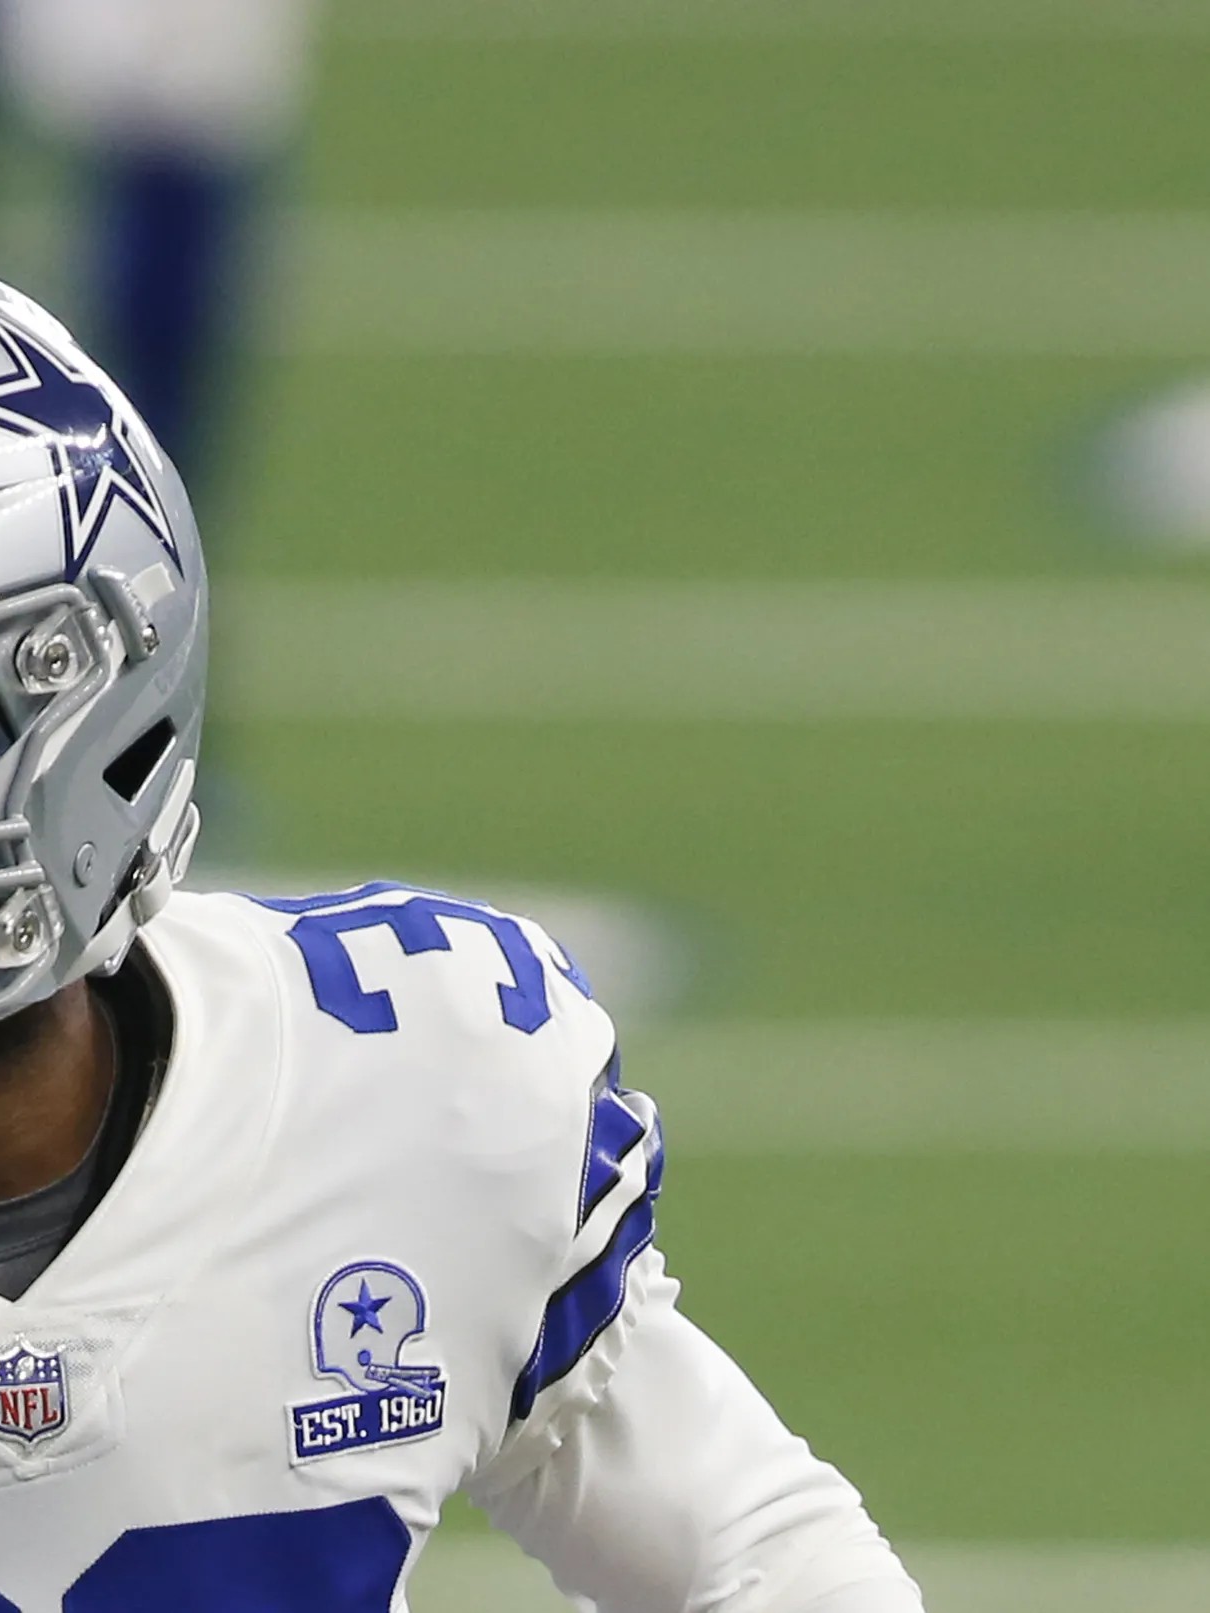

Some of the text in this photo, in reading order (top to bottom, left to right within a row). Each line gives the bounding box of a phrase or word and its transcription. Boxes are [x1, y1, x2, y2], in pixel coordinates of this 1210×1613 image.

[245, 880, 593, 1035] 3
[299, 1389, 442, 1449] EST. 1960
